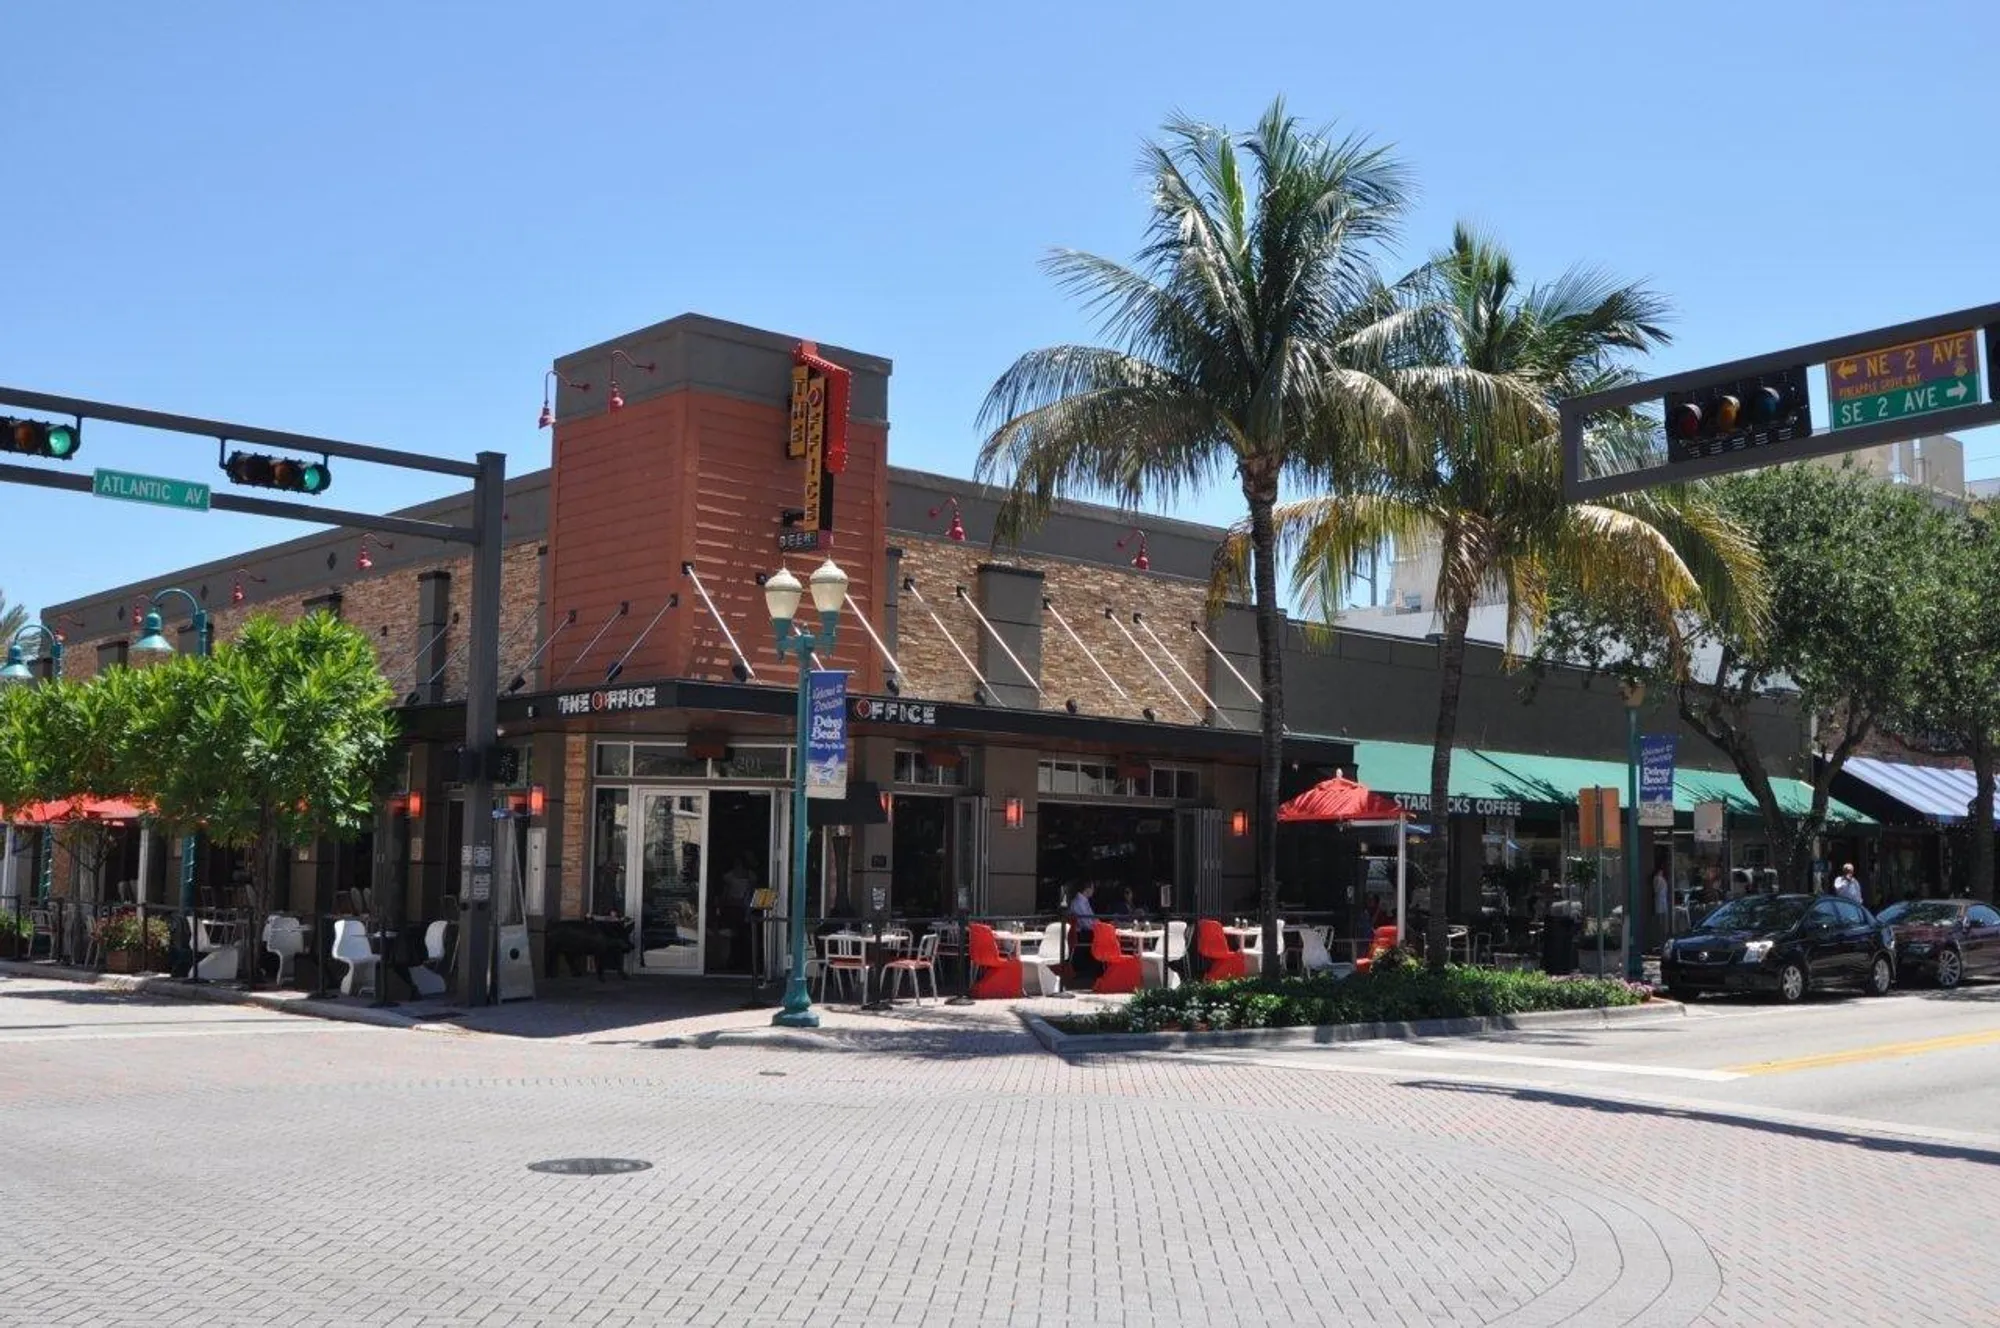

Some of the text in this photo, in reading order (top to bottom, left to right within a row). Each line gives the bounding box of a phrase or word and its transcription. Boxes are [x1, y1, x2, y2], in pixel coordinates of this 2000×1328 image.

[1866, 337, 1968, 377] NE 2 AVE
[1841, 387, 1938, 424] SE 2 AVE
[804, 387, 822, 522] OFFICE
[101, 475, 203, 505] ATLANTIC AV
[558, 687, 656, 714] THE OFFICE
[856, 699, 936, 724] OFFICE
[811, 726, 841, 740] Beach
[1394, 794, 1521, 815] STARCKS COFFEE
